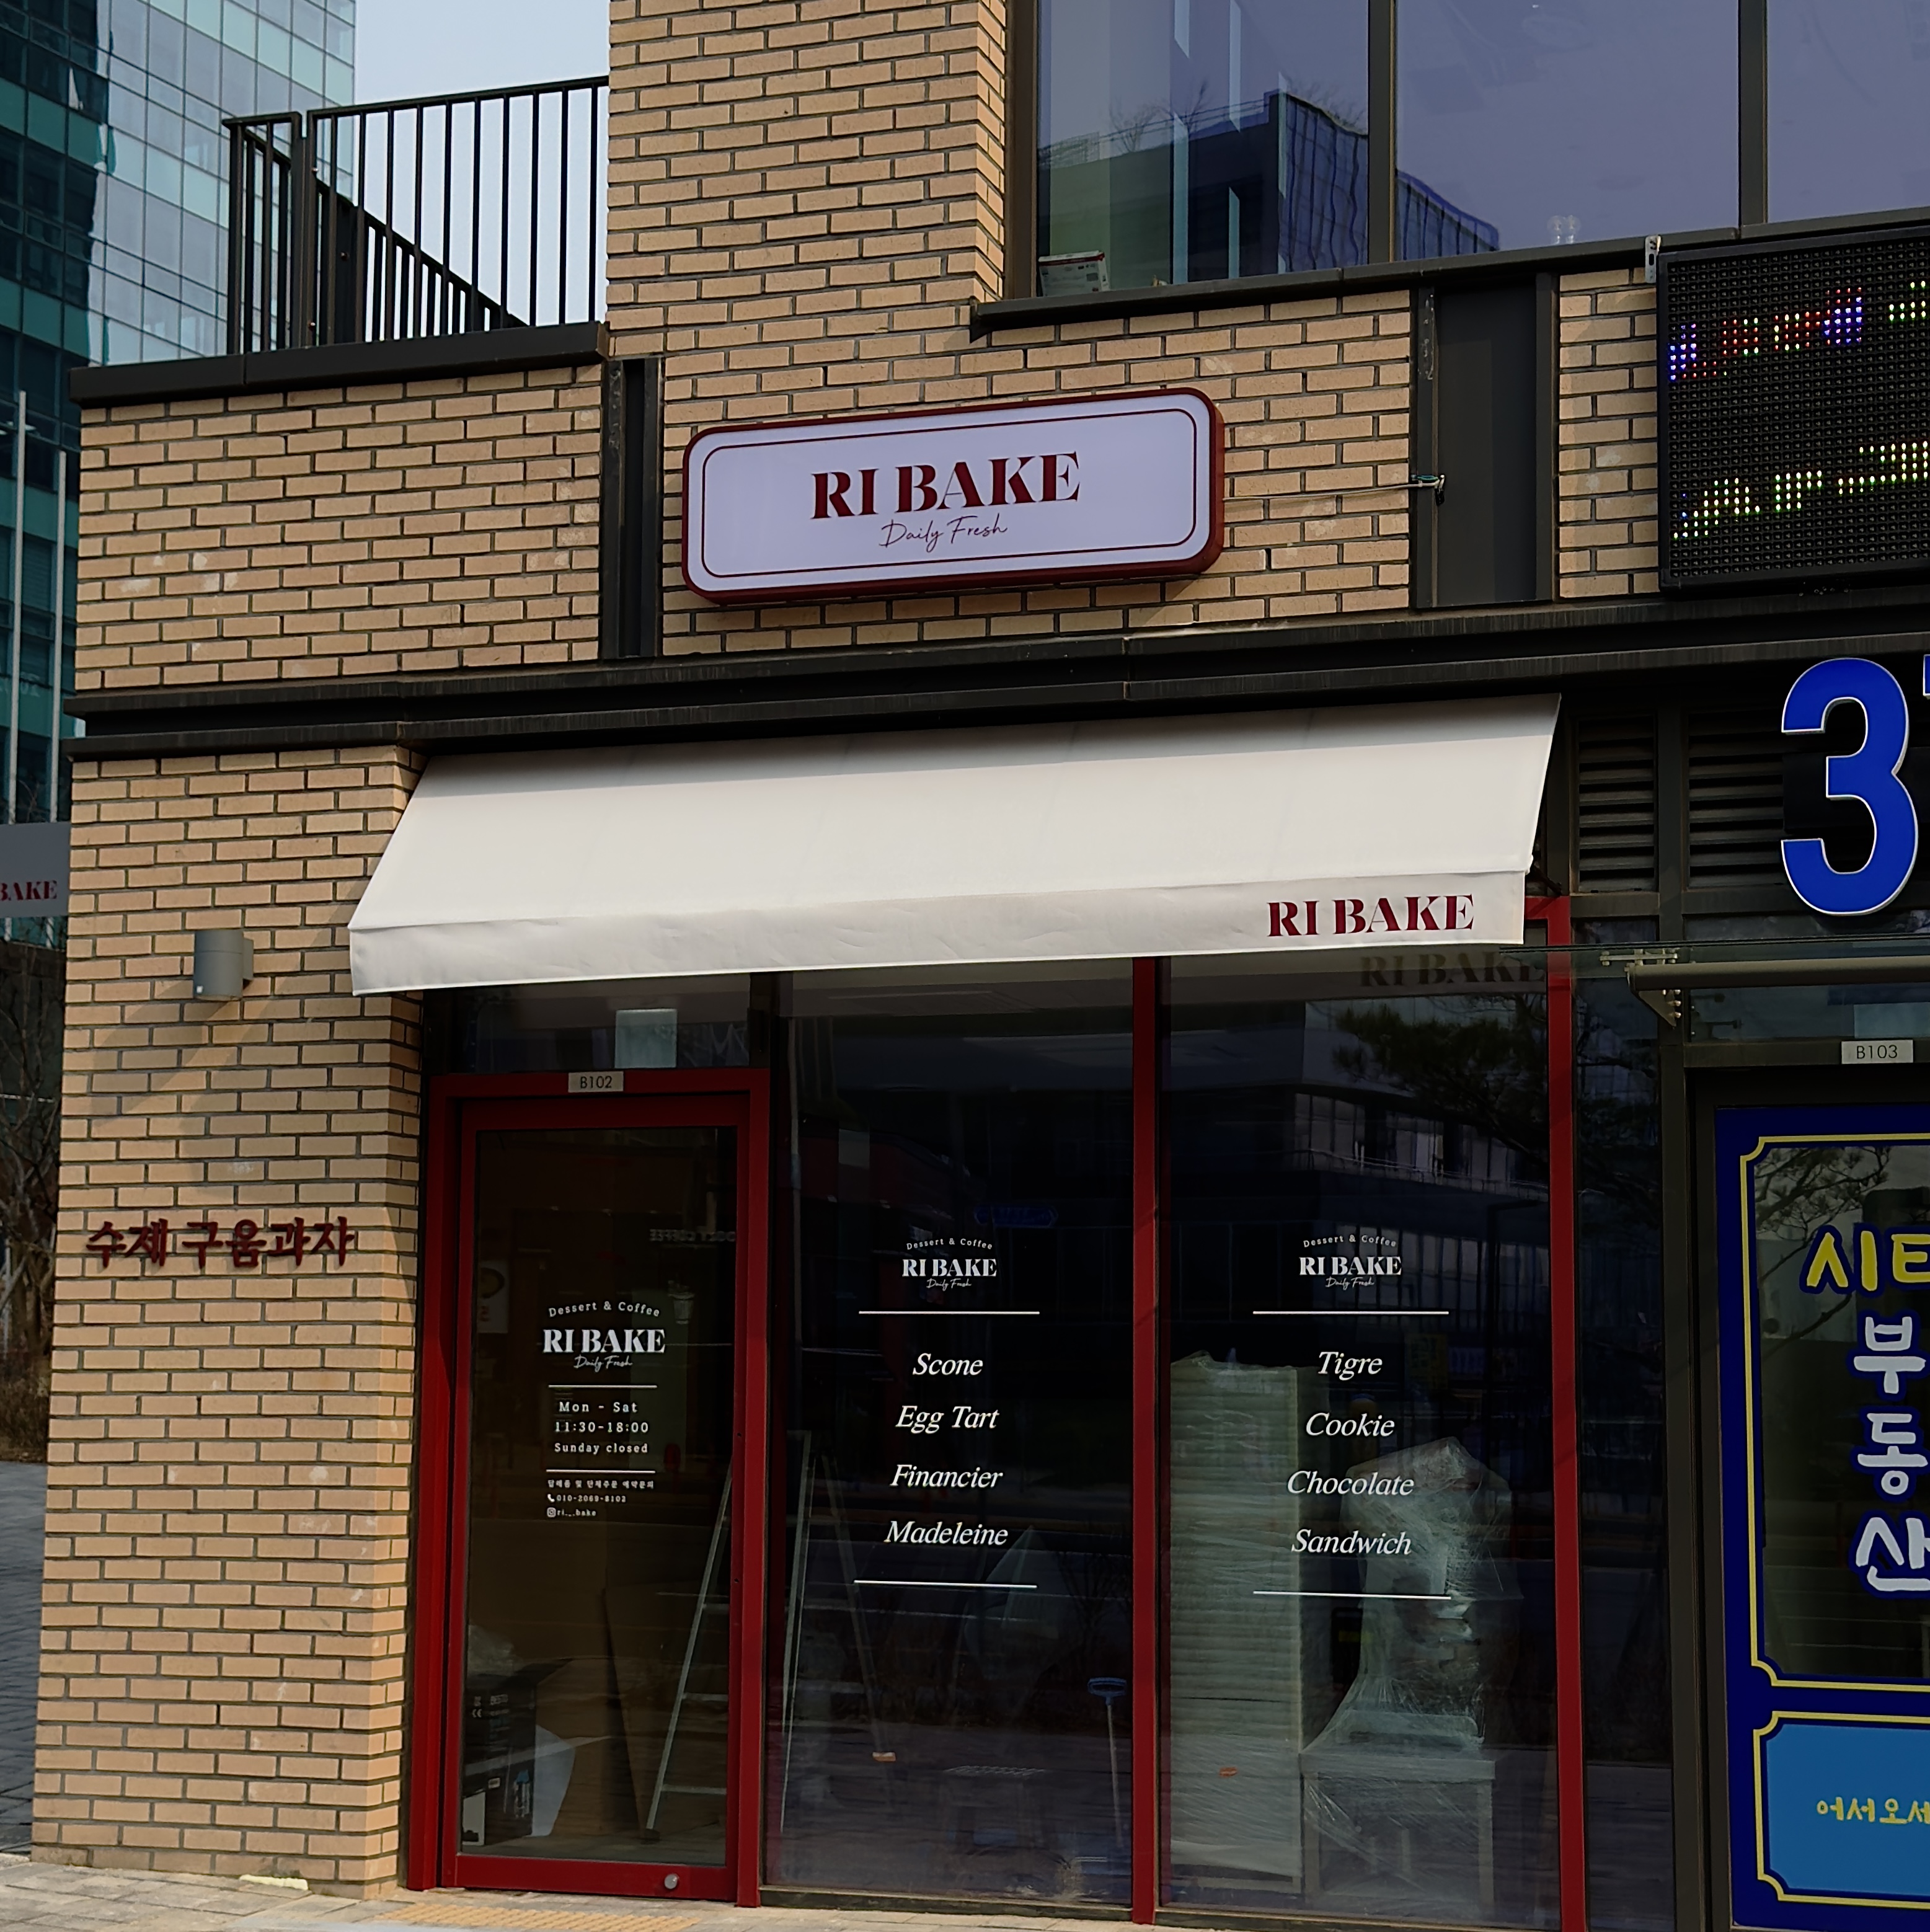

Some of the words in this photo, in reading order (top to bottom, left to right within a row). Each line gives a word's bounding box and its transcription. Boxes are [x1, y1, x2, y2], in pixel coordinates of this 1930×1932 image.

[810, 469, 879, 520] RI
[895, 451, 1080, 513] BAKE
[879, 518, 943, 552] Daily
[947, 513, 1008, 544] Fresh
[1781, 657, 1930, 915] 3
[1267, 900, 1320, 937] RI
[1332, 893, 1474, 934] BAKE
[1856, 1045, 1898, 1060] B103
[580, 1076, 613, 1089] B102
[86, 1218, 168, 1268] 수제
[182, 1216, 355, 1269] 구움과자
[906, 1239, 944, 1250] Dessert
[960, 1238, 993, 1249] Coffee
[1303, 1235, 1343, 1247] Dessert
[1348, 1234, 1356, 1243] &
[1361, 1235, 1396, 1247] Coffee
[902, 1259, 927, 1277] RI
[932, 1259, 997, 1277] BAKE
[1299, 1256, 1326, 1275] RI
[1331, 1256, 1402, 1275] BAKE
[549, 1302, 597, 1317] Dessert
[603, 1301, 612, 1310] &
[618, 1301, 660, 1317] Coffee
[542, 1329, 575, 1353] RI
[581, 1329, 665, 1353] BAKE
[912, 1352, 983, 1376] Scone
[1317, 1351, 1383, 1381] Tigre
[559, 1402, 590, 1412] Mon
[613, 1402, 638, 1412] Sat
[895, 1405, 944, 1434] Egg
[952, 1406, 999, 1429] Tart
[1306, 1412, 1395, 1437] Cookie
[554, 1443, 600, 1455] Sunday
[606, 1443, 648, 1453] closed
[890, 1464, 1004, 1489] Financier
[1287, 1470, 1414, 1496] Chocolate
[883, 1520, 1009, 1546] Madeleine
[1291, 1528, 1412, 1554] Sandwich
